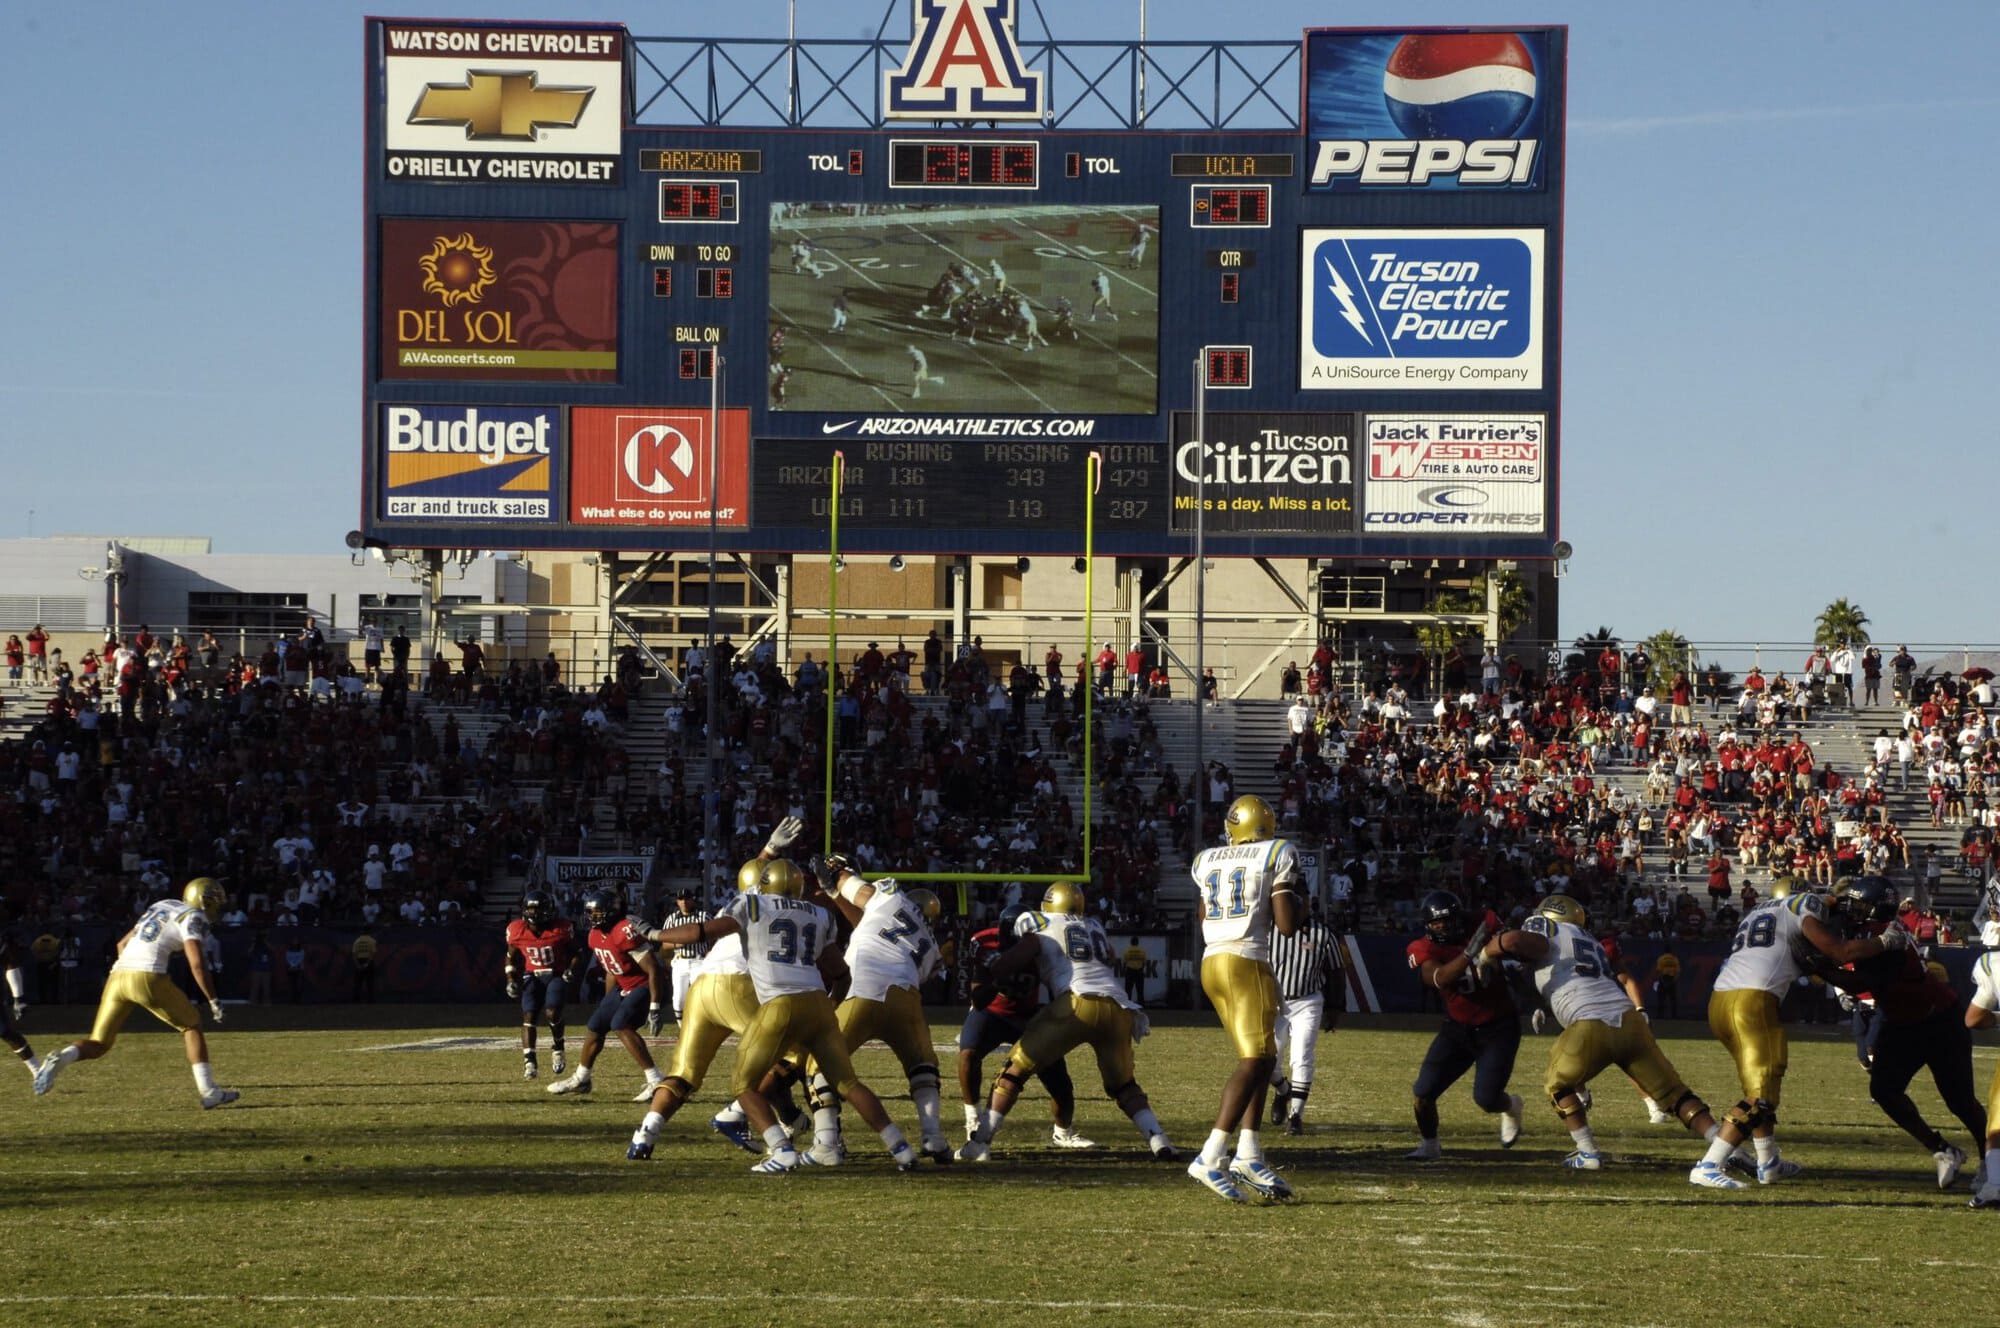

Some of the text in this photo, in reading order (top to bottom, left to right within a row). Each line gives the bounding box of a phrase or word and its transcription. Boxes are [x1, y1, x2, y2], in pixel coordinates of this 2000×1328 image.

[390, 31, 613, 54] WATSON CHEVROLET
[388, 157, 613, 180] O'RIELLY CHEVROLET
[659, 151, 742, 172] ARIZONA
[808, 155, 844, 171] TOL
[926, 146, 1034, 183] 2:12
[1084, 158, 1120, 174] TOL
[1205, 156, 1255, 175] UCLA
[1311, 138, 1539, 186] PEPSI
[663, 184, 719, 218] 34
[1211, 190, 1267, 222] 27
[650, 245, 675, 261] DWN
[698, 246, 731, 261] TO GO
[1220, 251, 1241, 267] QTR
[1368, 253, 1480, 282] Tucson
[655, 268, 671, 296] 4
[716, 269, 732, 296] 6
[1223, 274, 1238, 301] 4
[1379, 283, 1510, 311] Electric
[399, 310, 518, 344] DEL SOL
[676, 327, 720, 342] BALL ON
[1391, 313, 1509, 341] Power
[402, 351, 516, 366] AVAconcerts.com
[1209, 351, 1248, 384] 00
[1311, 366, 1528, 382] A UniSource Energy Company
[388, 407, 550, 466] Budget
[857, 418, 1095, 437] ARIZONAATHLETICS.COM
[1373, 424, 1538, 442] Jack Furrier's
[1260, 429, 1348, 453] Tucson
[866, 443, 1160, 463] RUSHING PASSING TOTAL
[1176, 441, 1353, 485] Citizen
[1372, 443, 1539, 478] WESTERN
[888, 467, 925, 486] 136
[1007, 468, 1046, 487] 343
[1110, 469, 1149, 487] 479
[1421, 463, 1535, 476] TIRE & AUTO CARE
[391, 499, 546, 516] car and truck sales
[581, 506, 735, 521] What else do you ned?
[1109, 501, 1148, 519] 287
[1175, 496, 1351, 513] Miss a day. Miss a lot.
[1548, 650, 1560, 664] 29
[639, 845, 656, 856] 28
[559, 865, 642, 882] BRUEGGER'S
[1964, 867, 1982, 878] 30
[1205, 867, 1250, 920] 11
[767, 918, 817, 966] 31
[526, 945, 555, 967] 20
